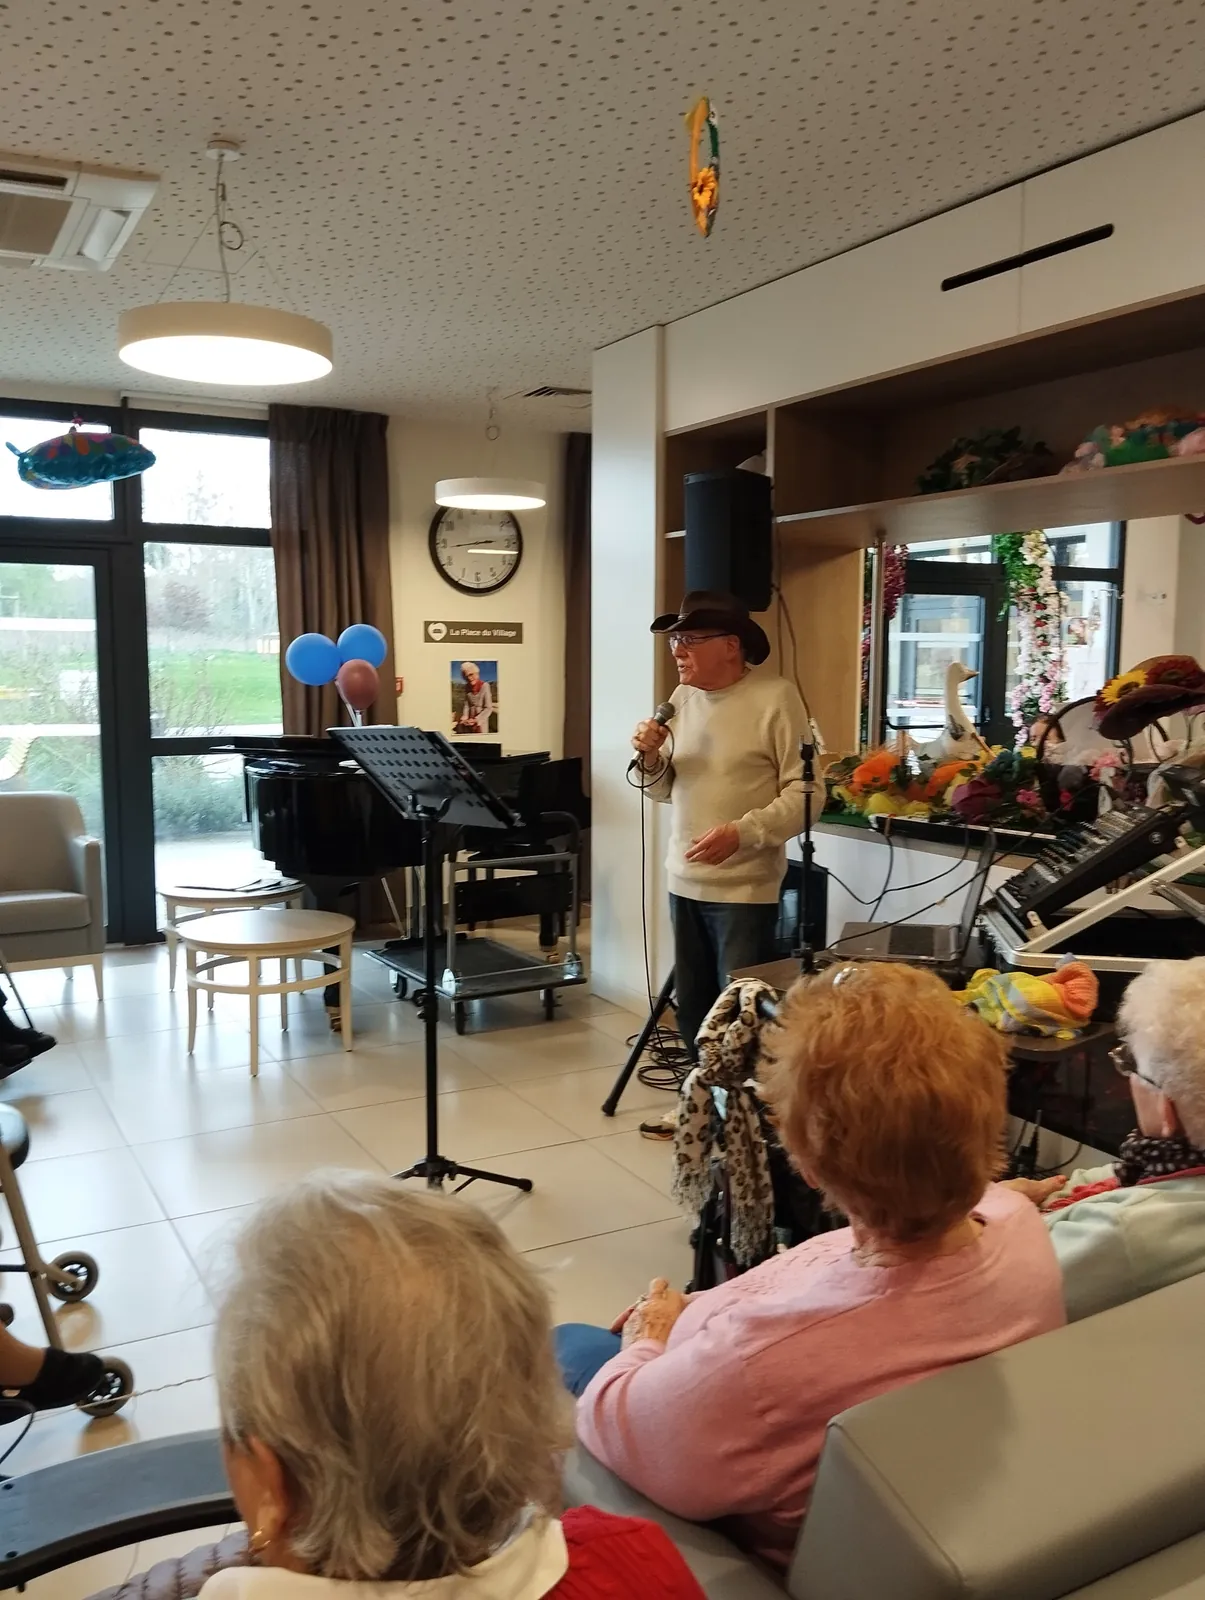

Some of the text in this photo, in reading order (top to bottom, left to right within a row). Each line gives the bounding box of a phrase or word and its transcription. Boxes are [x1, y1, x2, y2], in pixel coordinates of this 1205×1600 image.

[504, 538, 512, 549] 3
[449, 628, 460, 636] La
[461, 628, 481, 636] Place
[492, 629, 517, 638] Village
